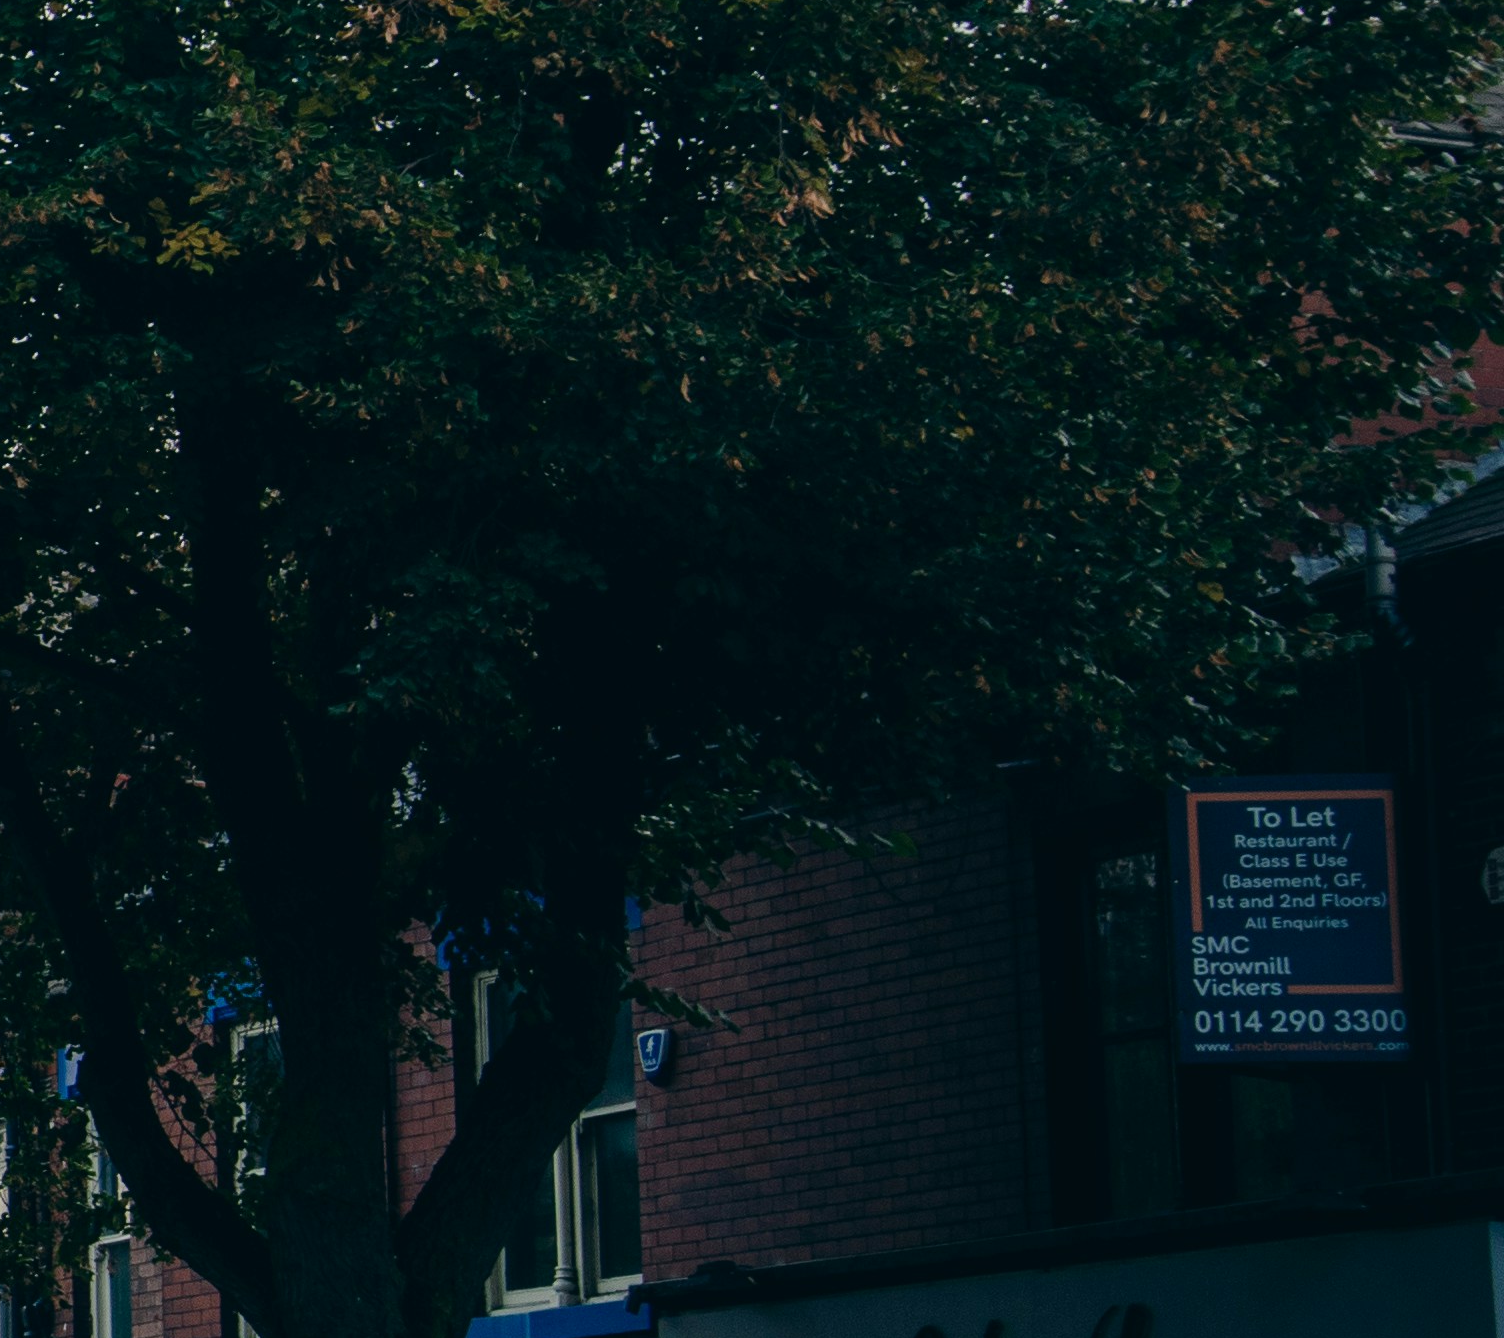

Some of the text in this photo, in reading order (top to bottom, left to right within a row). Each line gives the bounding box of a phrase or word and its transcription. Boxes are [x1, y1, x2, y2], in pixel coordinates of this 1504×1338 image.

[1246, 806, 1336, 828] To Let
[1234, 834, 1337, 848] Restaurant
[1239, 853, 1348, 868] Class E Use
[1222, 872, 1367, 890] (Basement, GF,
[1206, 891, 1387, 909] 1st and 2nd Floors)
[1245, 916, 1349, 932] All Enquiries
[1192, 935, 1250, 955] SMC
[1193, 956, 1292, 976] Brownill
[1192, 978, 1283, 997] Vickers
[1194, 1009, 1407, 1034] 0114 290 3300
